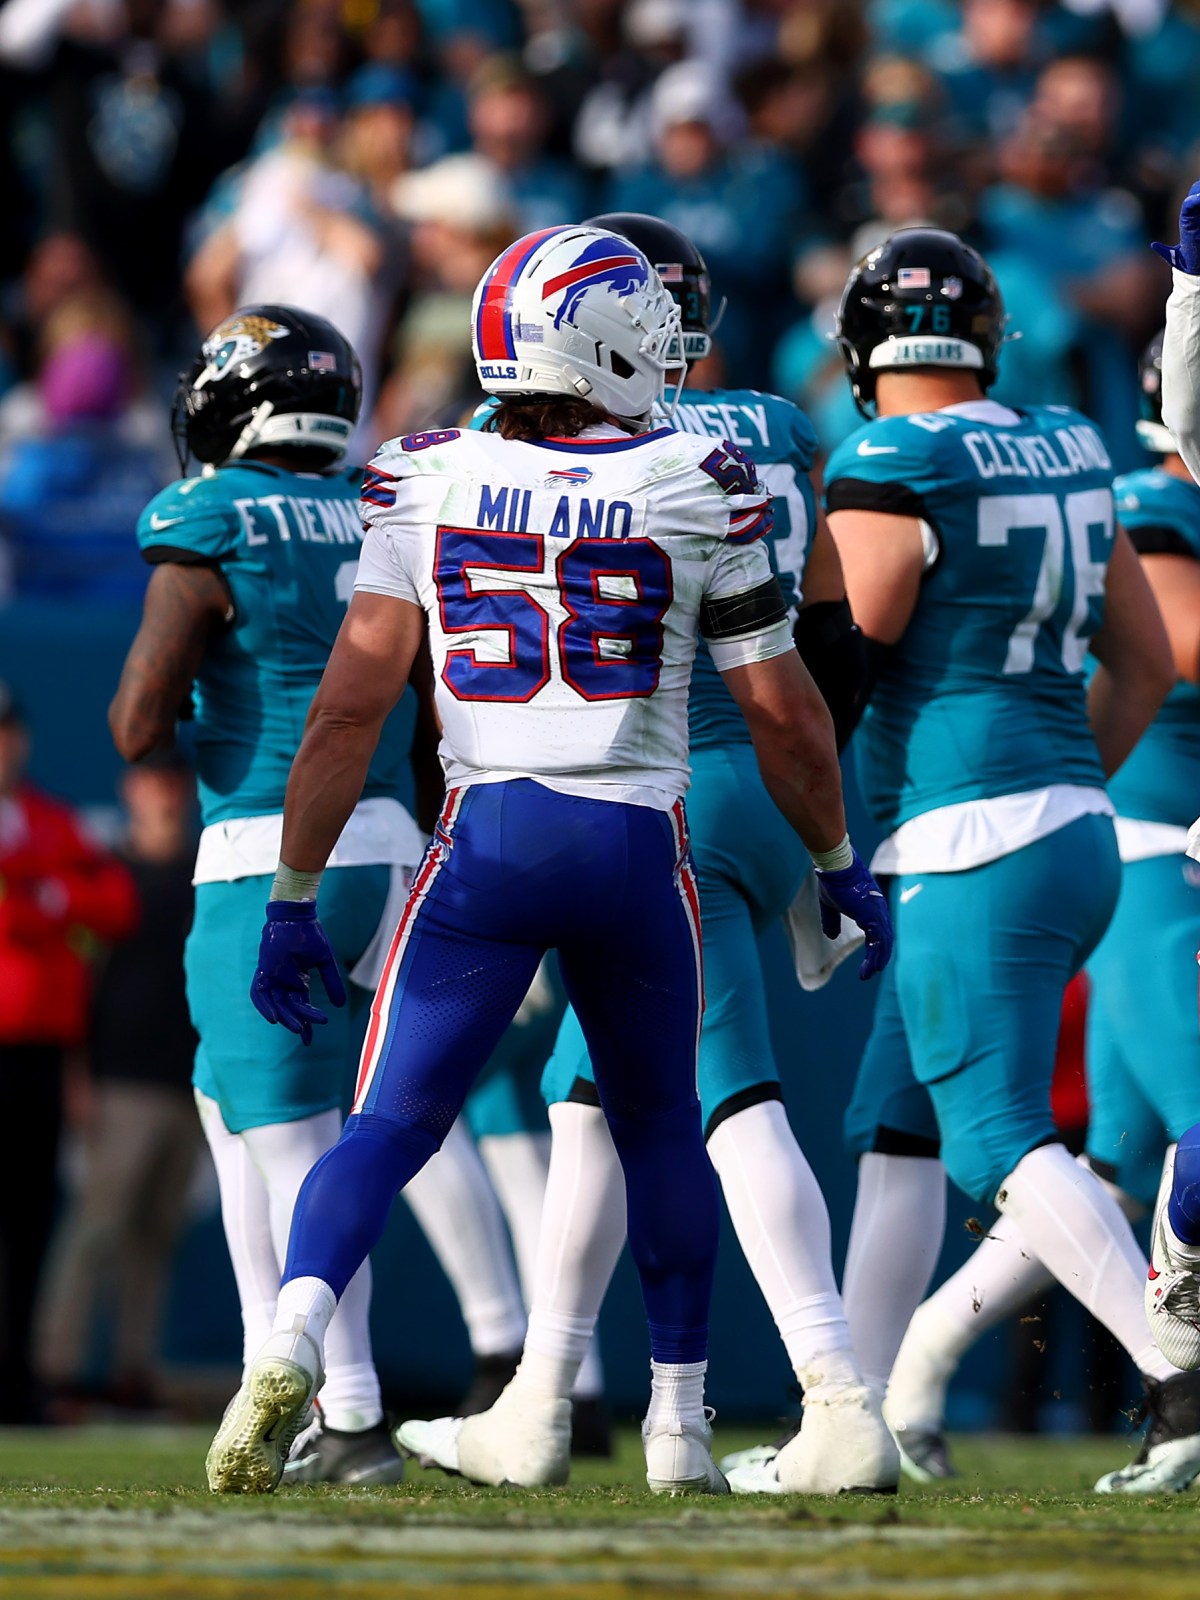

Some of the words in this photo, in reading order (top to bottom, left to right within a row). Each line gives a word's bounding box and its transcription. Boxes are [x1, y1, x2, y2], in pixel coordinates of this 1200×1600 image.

[905, 304, 951, 333] 76
[401, 429, 461, 452] 8
[962, 424, 1112, 479] CLEVELAND
[233, 494, 366, 546] ETIENN
[477, 484, 633, 539] MILANO
[977, 487, 1115, 675] 76
[433, 525, 674, 703] 58
